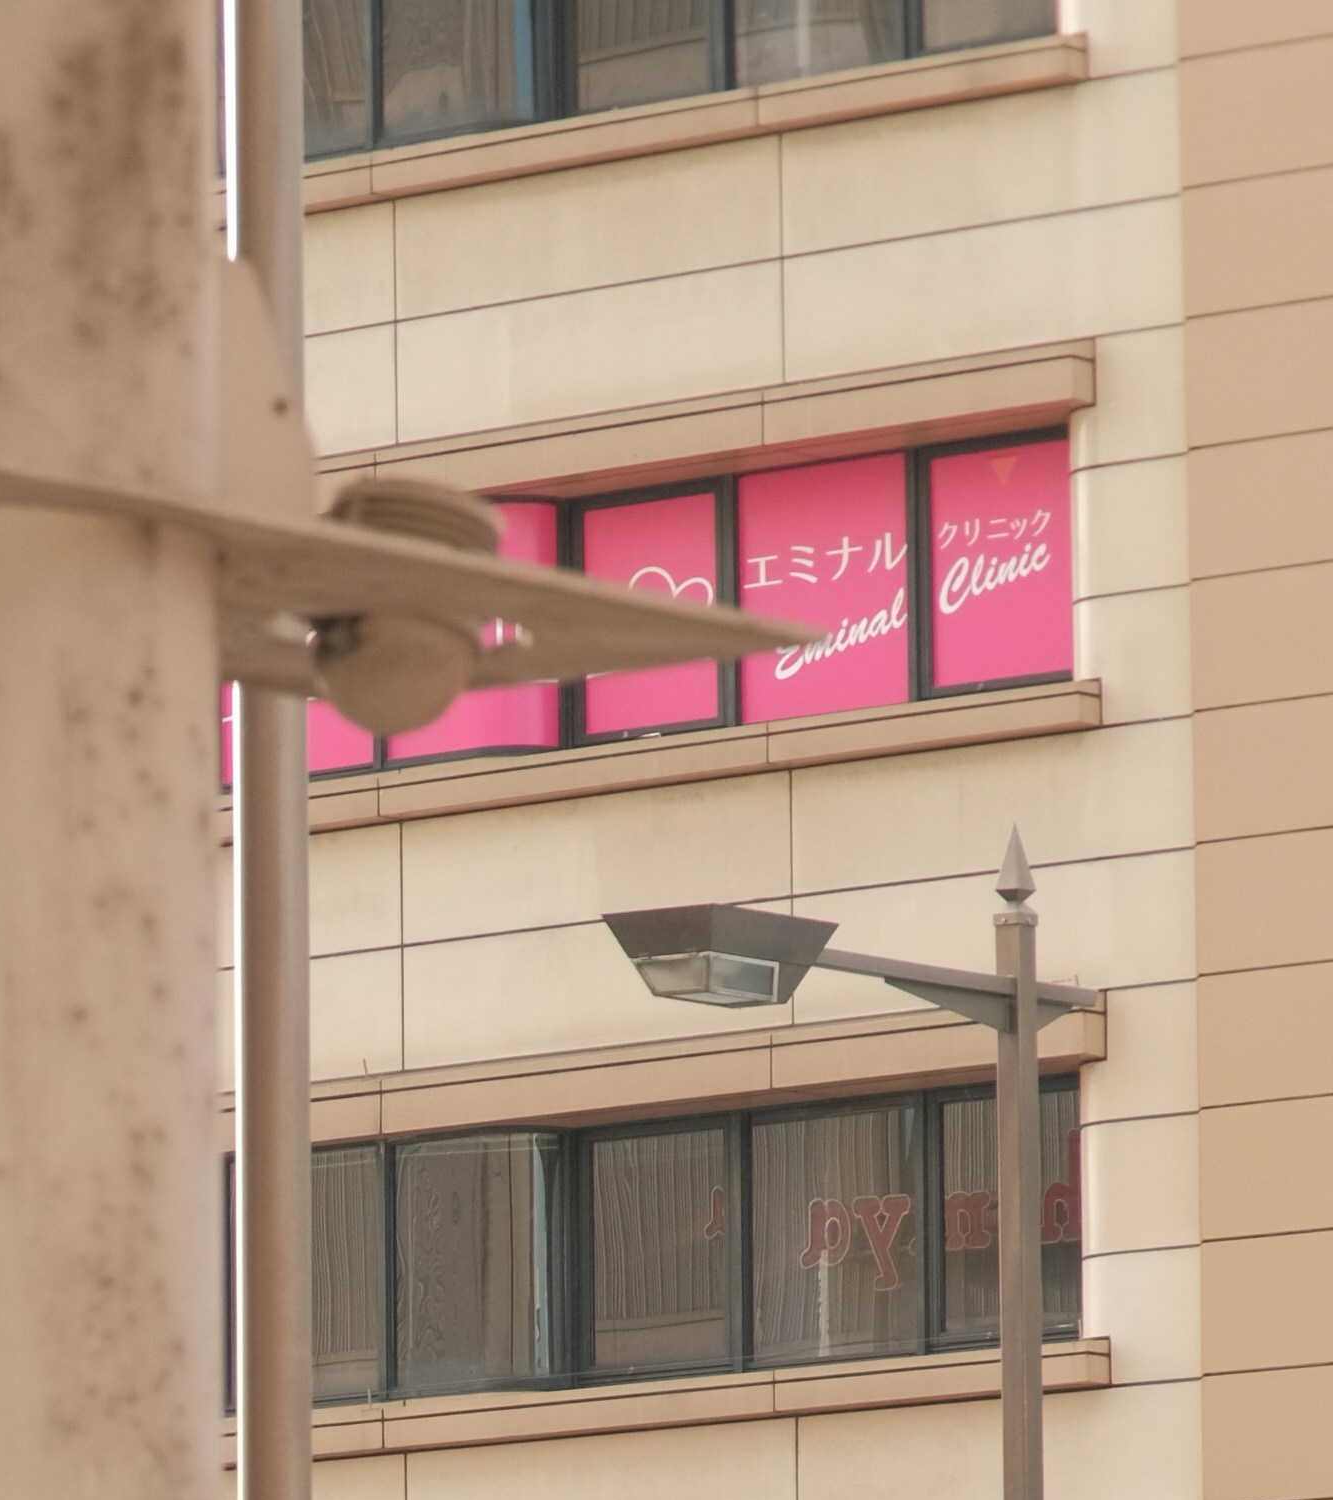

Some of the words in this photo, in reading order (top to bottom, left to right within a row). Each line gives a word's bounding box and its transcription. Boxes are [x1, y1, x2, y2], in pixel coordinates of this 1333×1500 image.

[744, 531, 908, 590] エミナル
[938, 508, 1052, 550] クリニック
[937, 541, 1052, 617] Clinic
